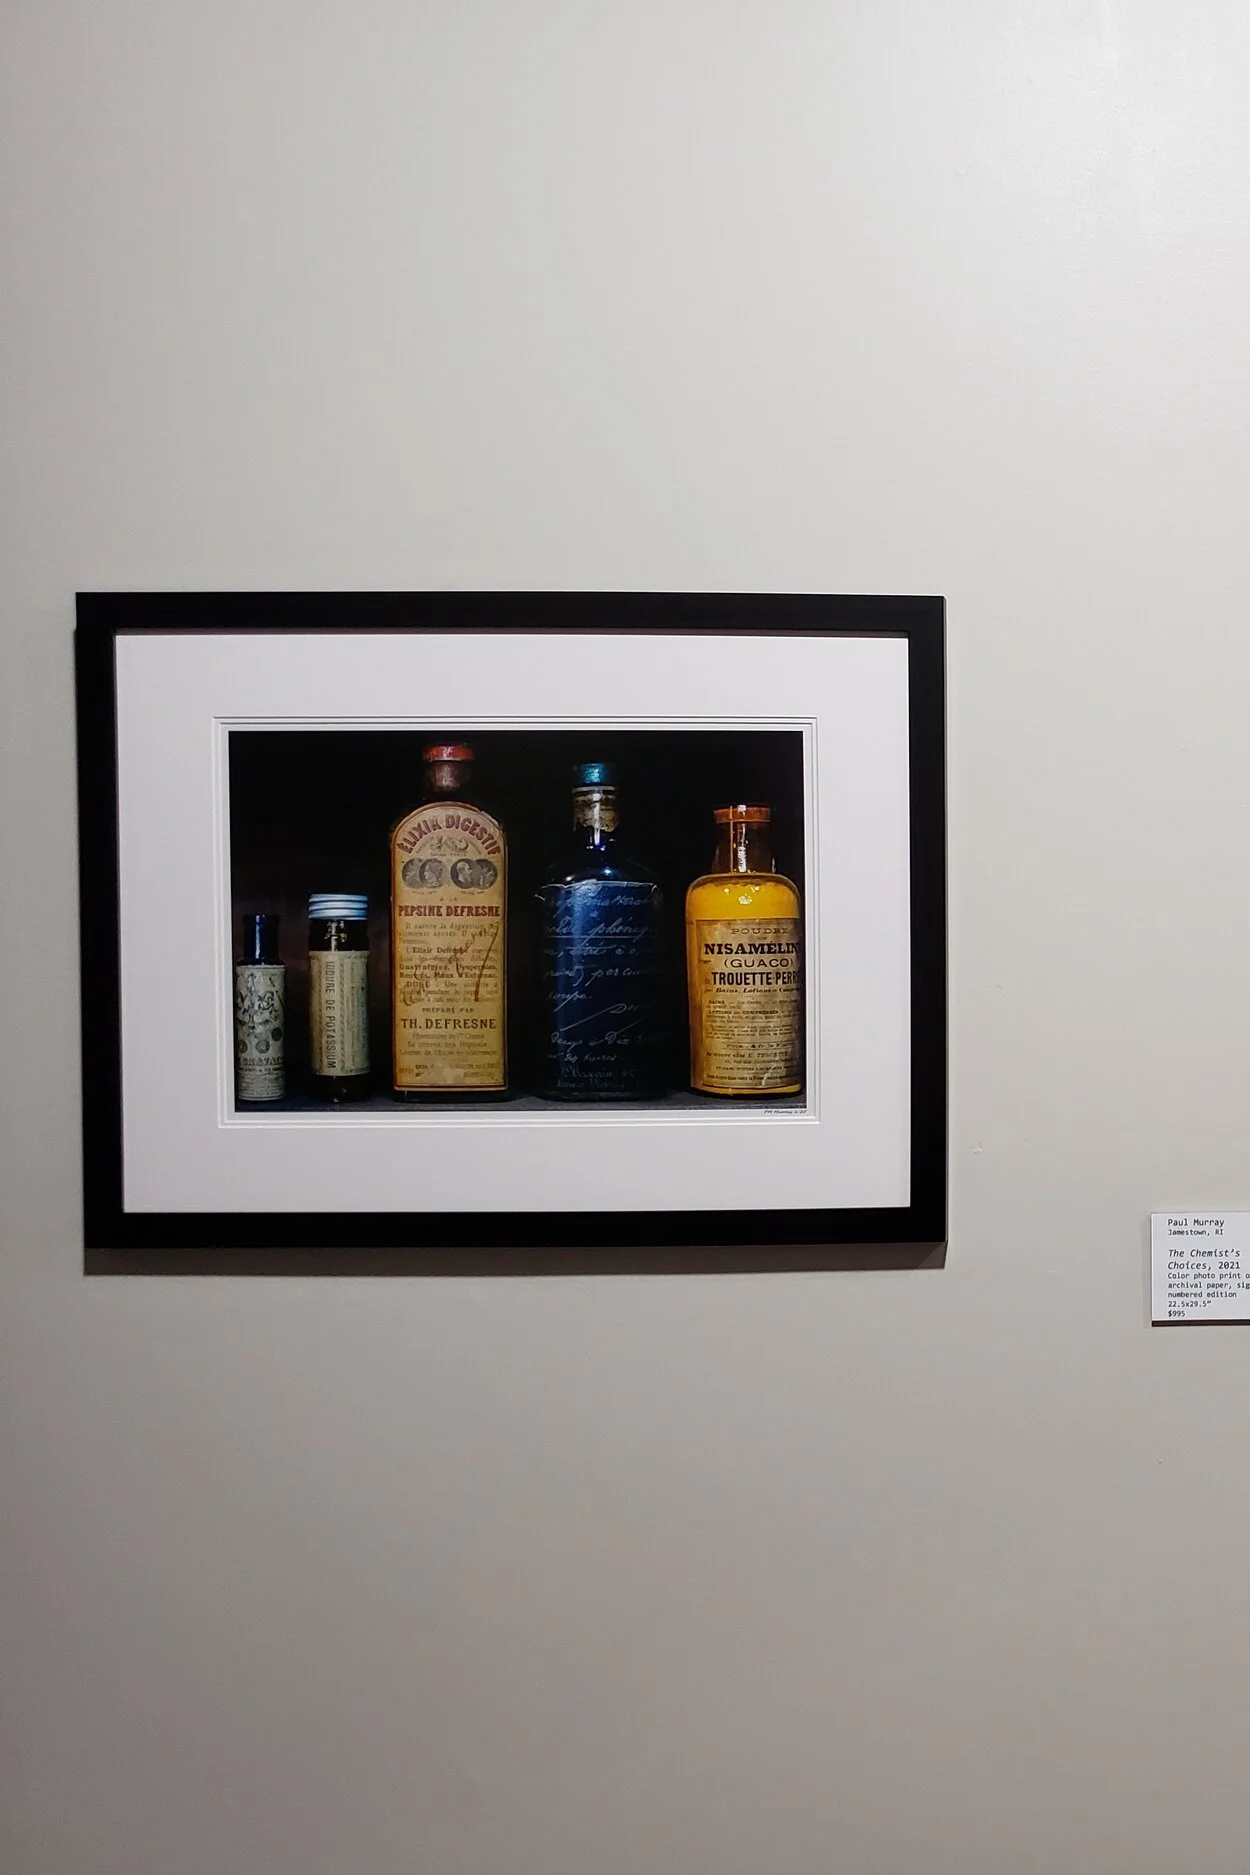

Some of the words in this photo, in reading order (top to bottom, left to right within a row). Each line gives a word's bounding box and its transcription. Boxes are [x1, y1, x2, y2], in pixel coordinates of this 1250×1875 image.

[445, 814, 501, 855] DIGESTIF
[398, 905, 443, 917] PEPSINE
[730, 927, 789, 935] POUDRE
[724, 957, 794, 969] (GUACO)
[325, 1000, 336, 1011] DE
[401, 1018, 422, 1030] TH.
[426, 1018, 497, 1030] DEFRESNE
[325, 1016, 337, 1069] POTASSIUM
[1167, 1218, 1188, 1227] Paul
[1193, 1218, 1225, 1228] Murray
[1167, 1229, 1210, 1237] Jamestown,
[1168, 1249, 1185, 1258] The
[1167, 1261, 1212, 1271] Choices,
[1218, 1261, 1241, 1270] 2021
[1167, 1272, 1190, 1280] Color
[1193, 1272, 1216, 1281] photo
[1219, 1272, 1241, 1281] print
[1167, 1281, 1203, 1289] archival
[1206, 1282, 1232, 1290] paper,
[1167, 1290, 1203, 1298] numbered
[1206, 1290, 1237, 1298] edition
[1167, 1309, 1186, 1318] $995
